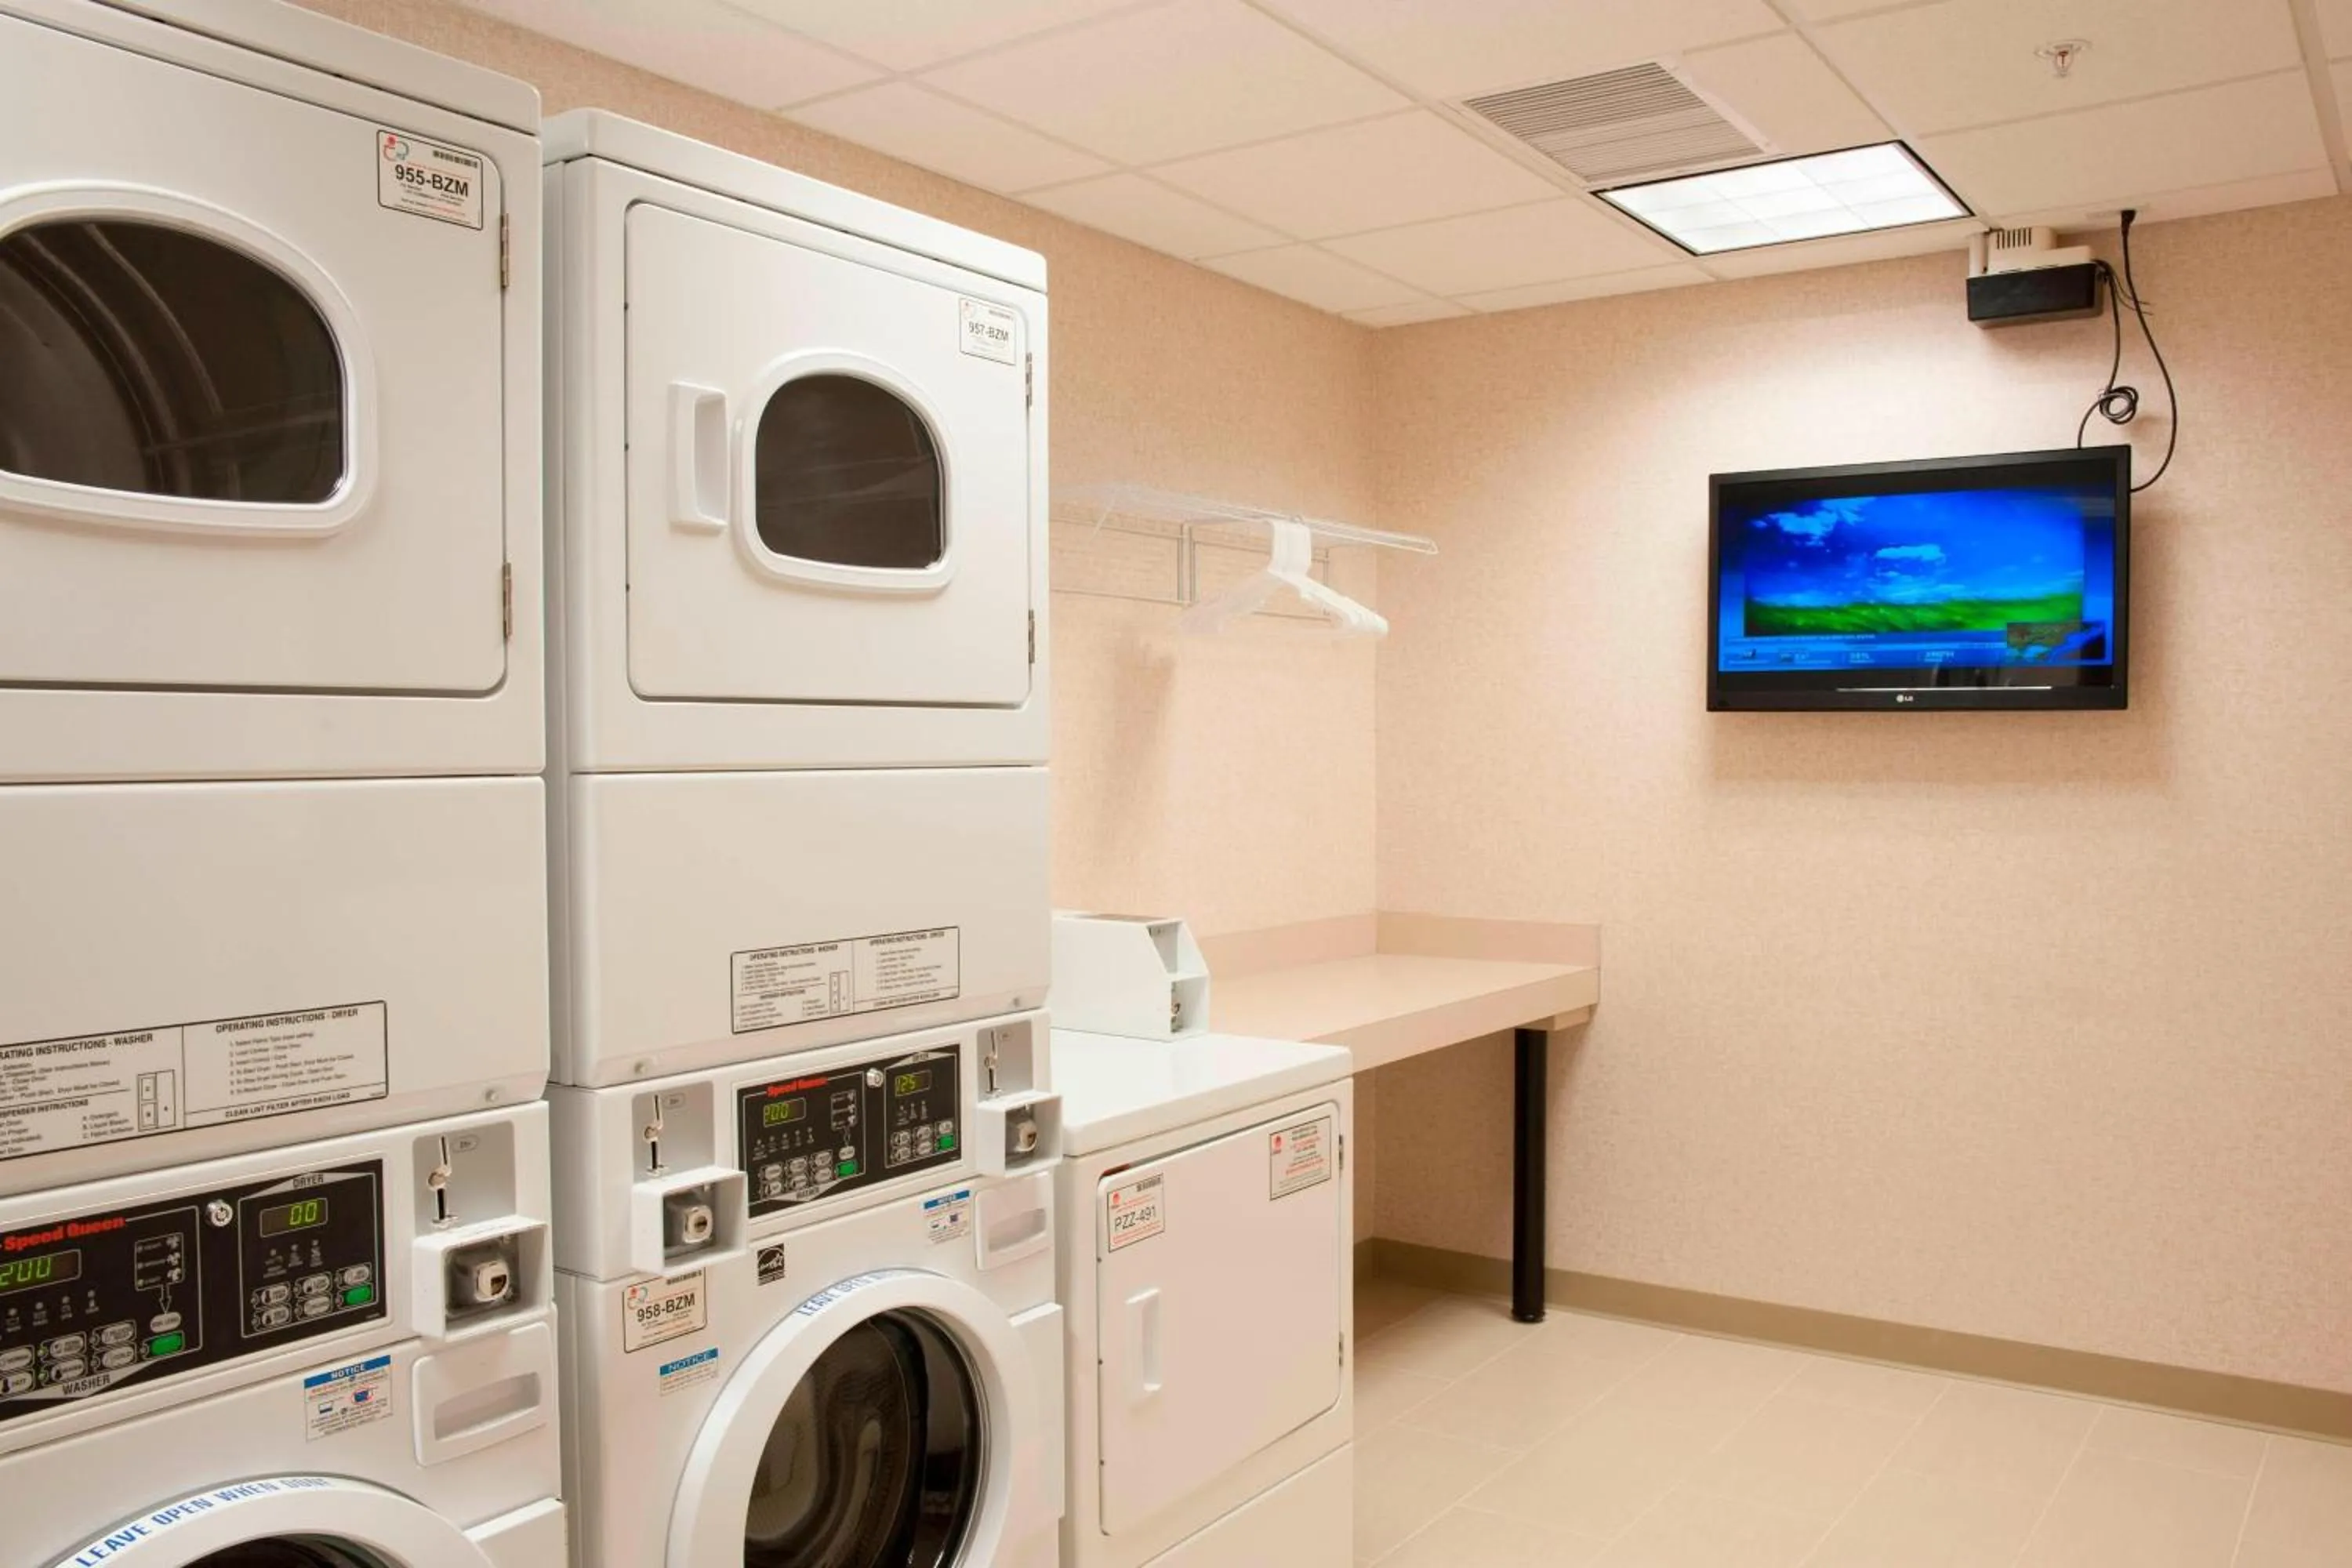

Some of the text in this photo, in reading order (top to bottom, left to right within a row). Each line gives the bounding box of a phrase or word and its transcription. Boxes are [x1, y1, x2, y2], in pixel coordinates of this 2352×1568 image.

[394, 164, 468, 197] 955-BZM
[968, 321, 1009, 341] 957-BZM
[216, 1020, 264, 1033] OPERATING
[266, 1012, 325, 1028] INSTRUCTIONS
[332, 1008, 358, 1018] DRYER
[35, 1039, 107, 1057] INSTRUCTIONS
[114, 1033, 154, 1047] WASHER
[293, 1174, 324, 1189] DRYER
[1114, 1205, 1156, 1232] PZZ-491
[4, 1217, 126, 1251] Speed Queen
[637, 1293, 696, 1323] 958-BZM
[330, 1364, 365, 1379] NOTICE
[62, 1374, 111, 1396] WASHER
[75, 1523, 152, 1567] LEAVE
[151, 1497, 215, 1525] OPEN
[216, 1482, 280, 1502] WHEN
